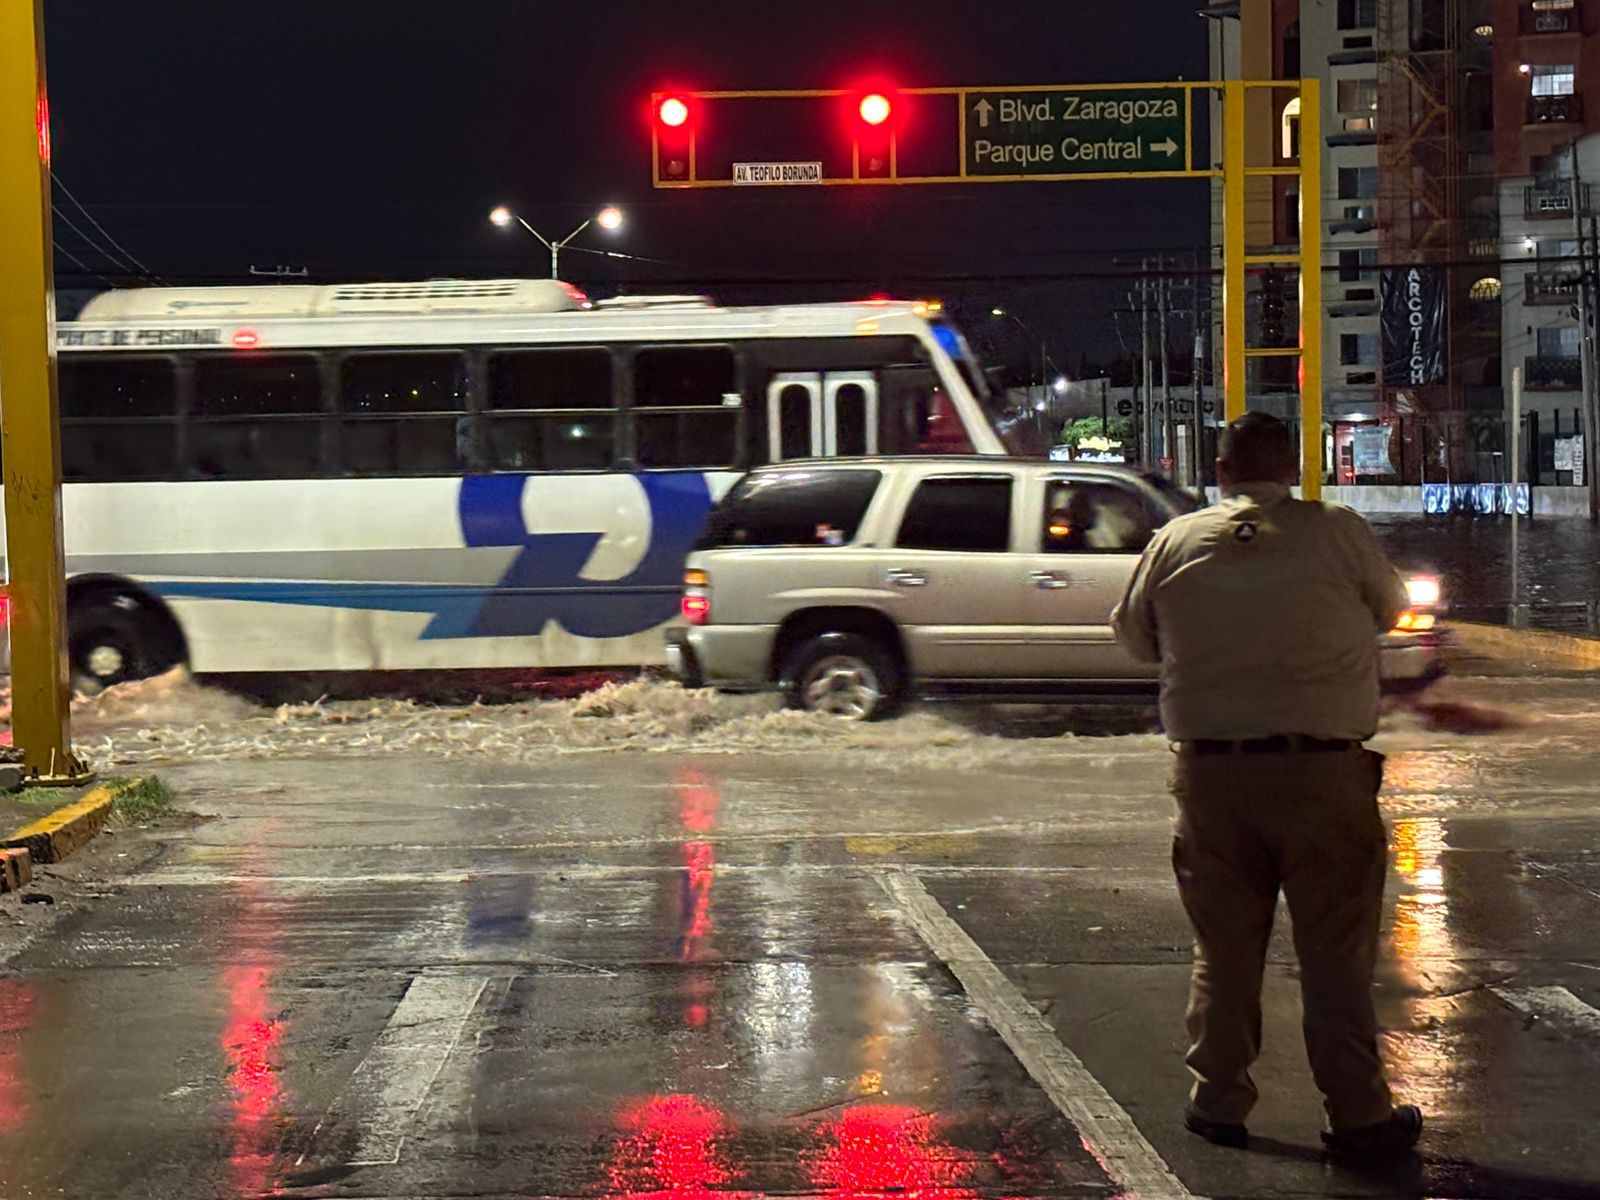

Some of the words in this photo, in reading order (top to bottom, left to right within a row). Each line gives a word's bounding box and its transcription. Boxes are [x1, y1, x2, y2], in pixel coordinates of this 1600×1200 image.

[1000, 99, 1054, 122] Blvd.
[1063, 97, 1178, 124] Zaragoza
[975, 140, 1054, 167] Parque
[1061, 136, 1141, 160] Central
[750, 166, 780, 181] TEOFILO
[783, 165, 818, 180] BORUNDA
[1408, 268, 1424, 385] ARCOTECH
